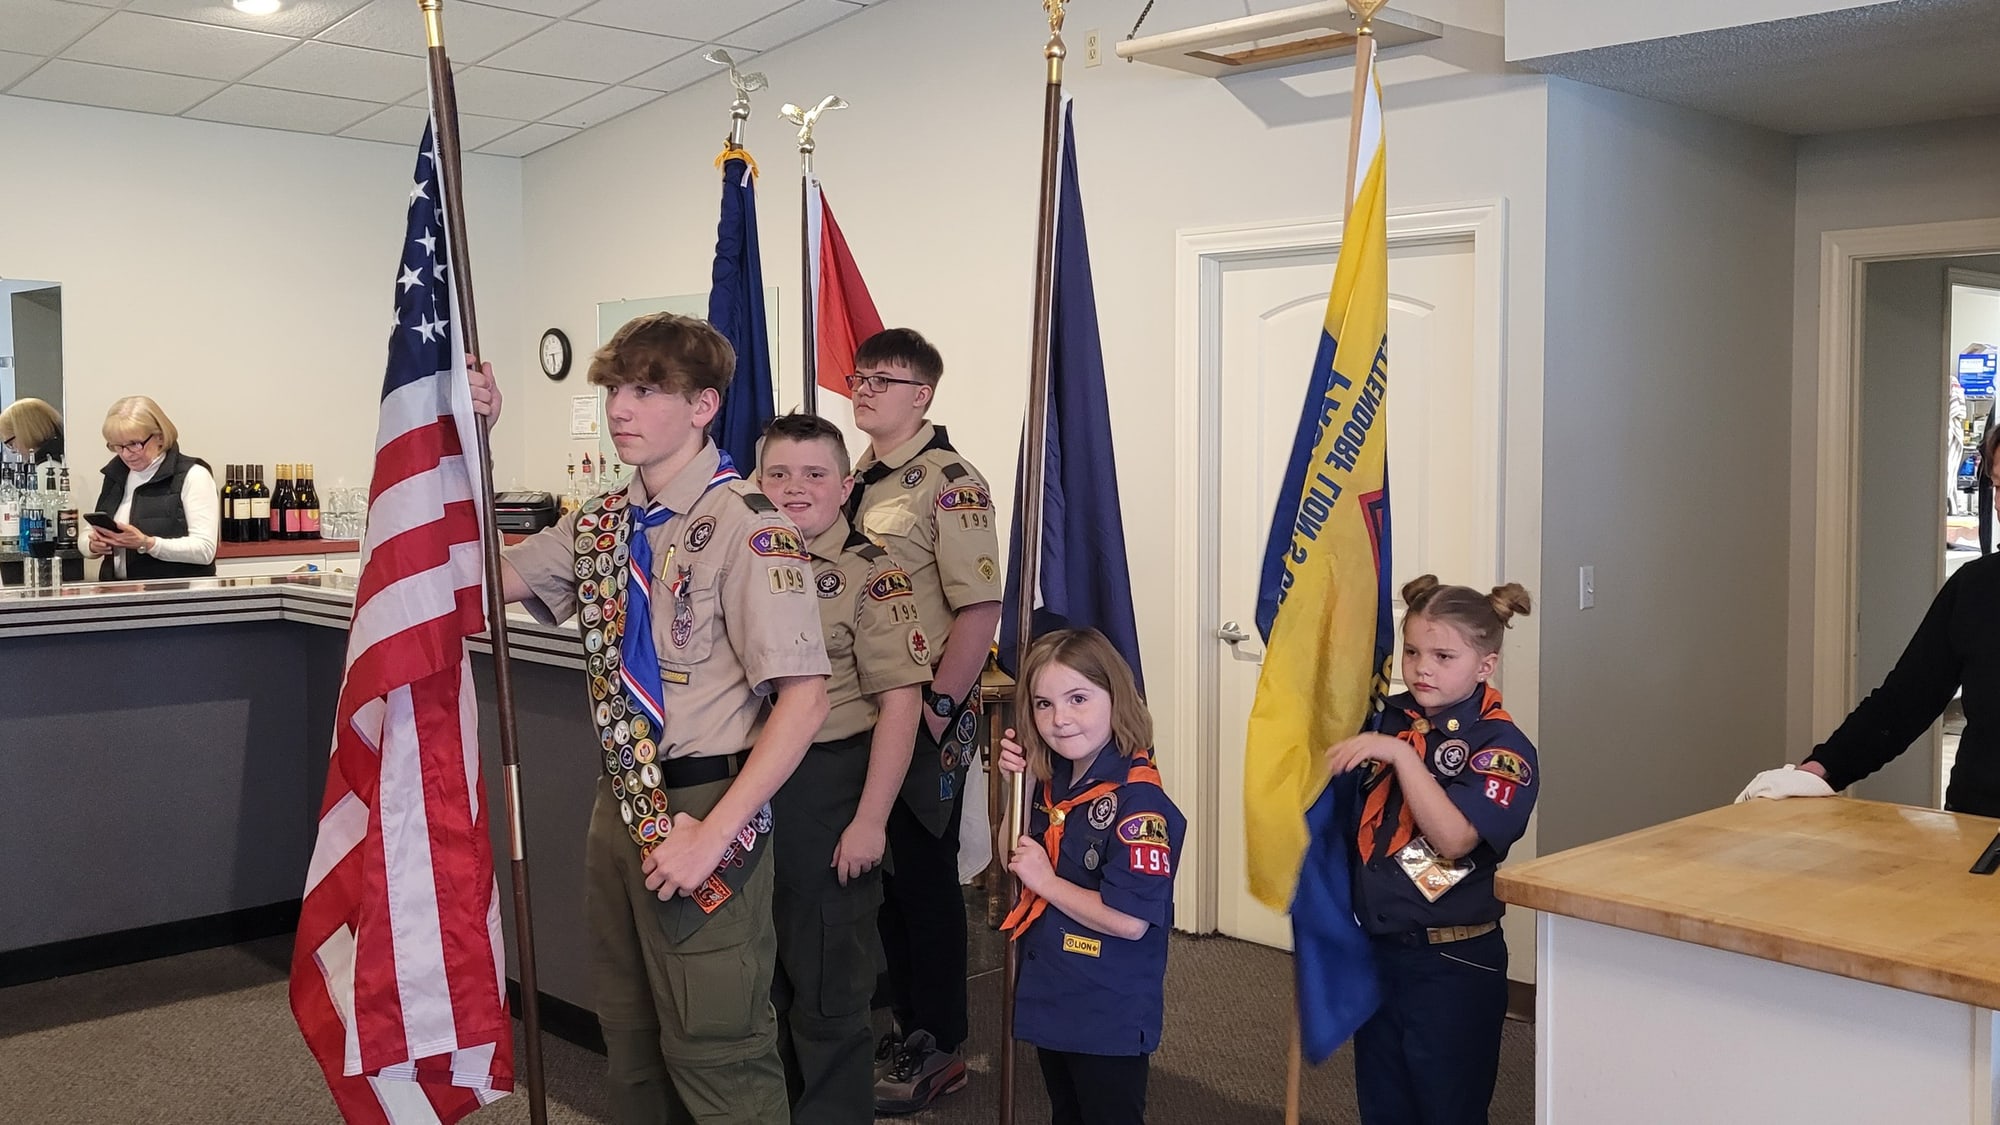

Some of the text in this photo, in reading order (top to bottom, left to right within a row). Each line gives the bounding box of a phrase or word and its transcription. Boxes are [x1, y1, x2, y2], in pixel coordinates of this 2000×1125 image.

[29, 509, 43, 521] UV
[961, 513, 988, 528] 199
[773, 568, 804, 589] 199
[891, 604, 918, 622] 199
[1486, 780, 1511, 805] 81
[1133, 847, 1170, 873] 199
[1074, 940, 1092, 951] LION
